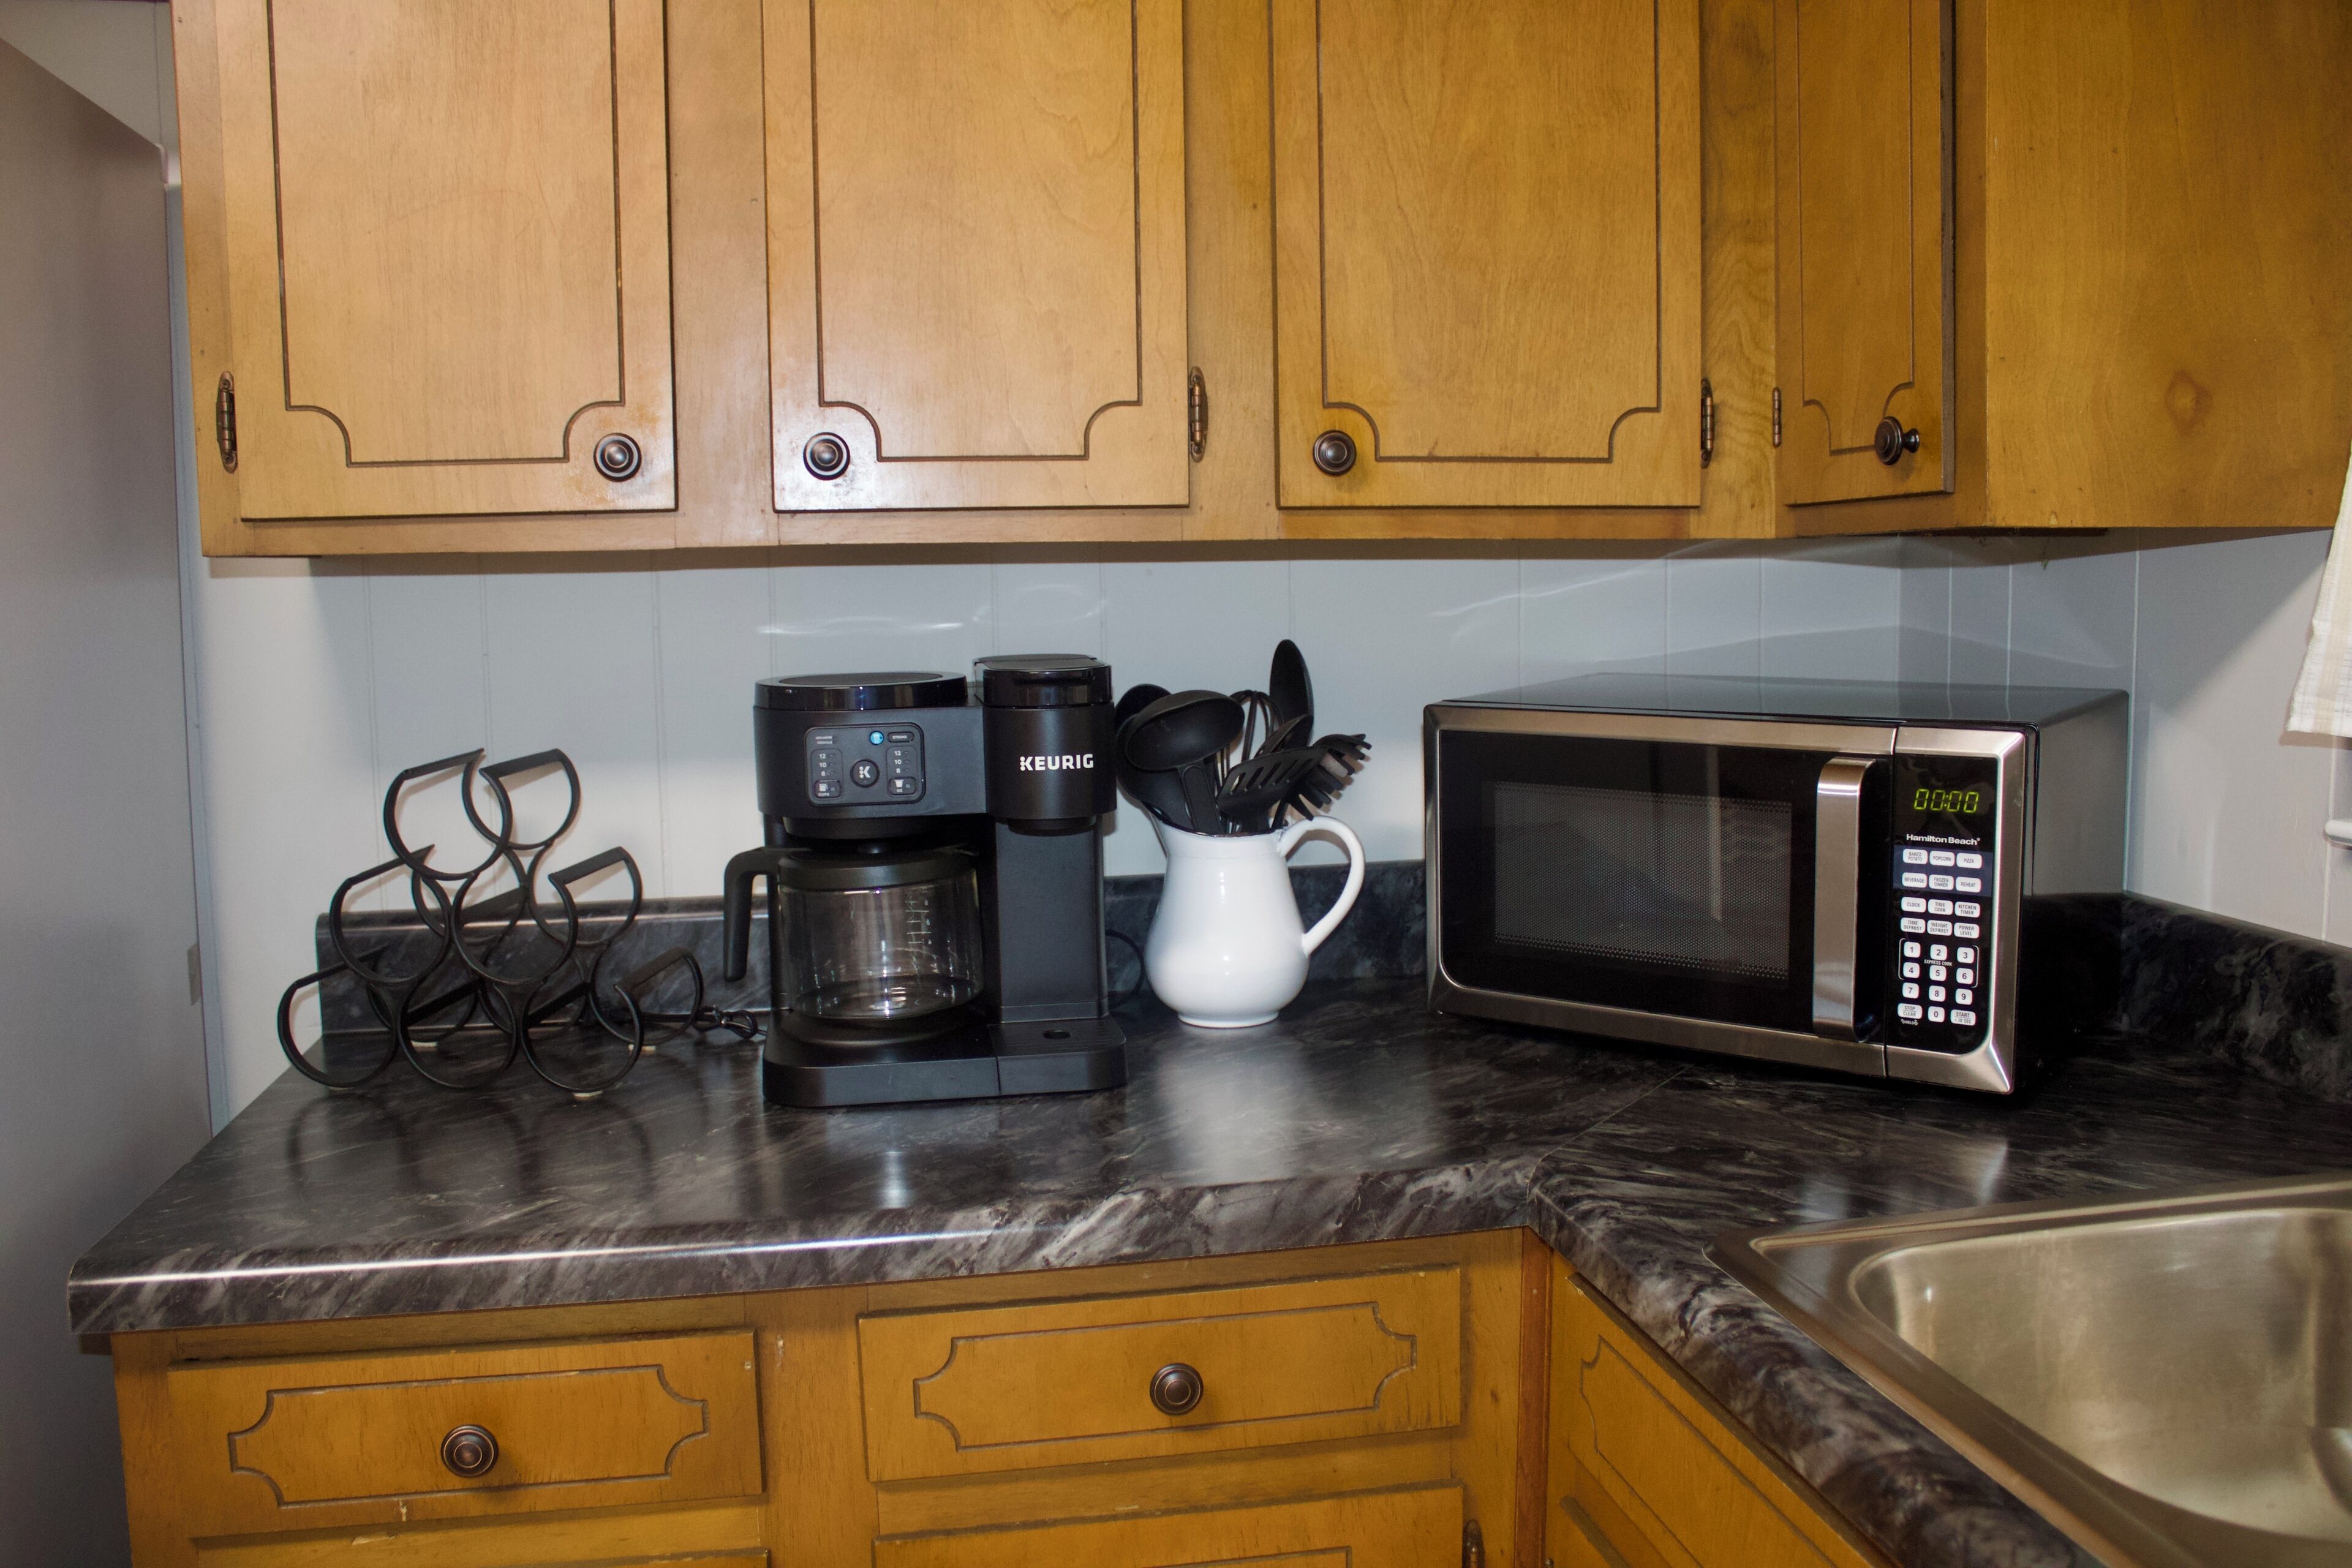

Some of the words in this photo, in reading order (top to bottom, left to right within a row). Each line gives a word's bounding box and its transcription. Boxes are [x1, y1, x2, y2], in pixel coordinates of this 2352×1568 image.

[1020, 753, 1094, 771] KEURIG
[1913, 788, 1980, 813] 00:00
[1906, 834, 1947, 843] Hamilton
